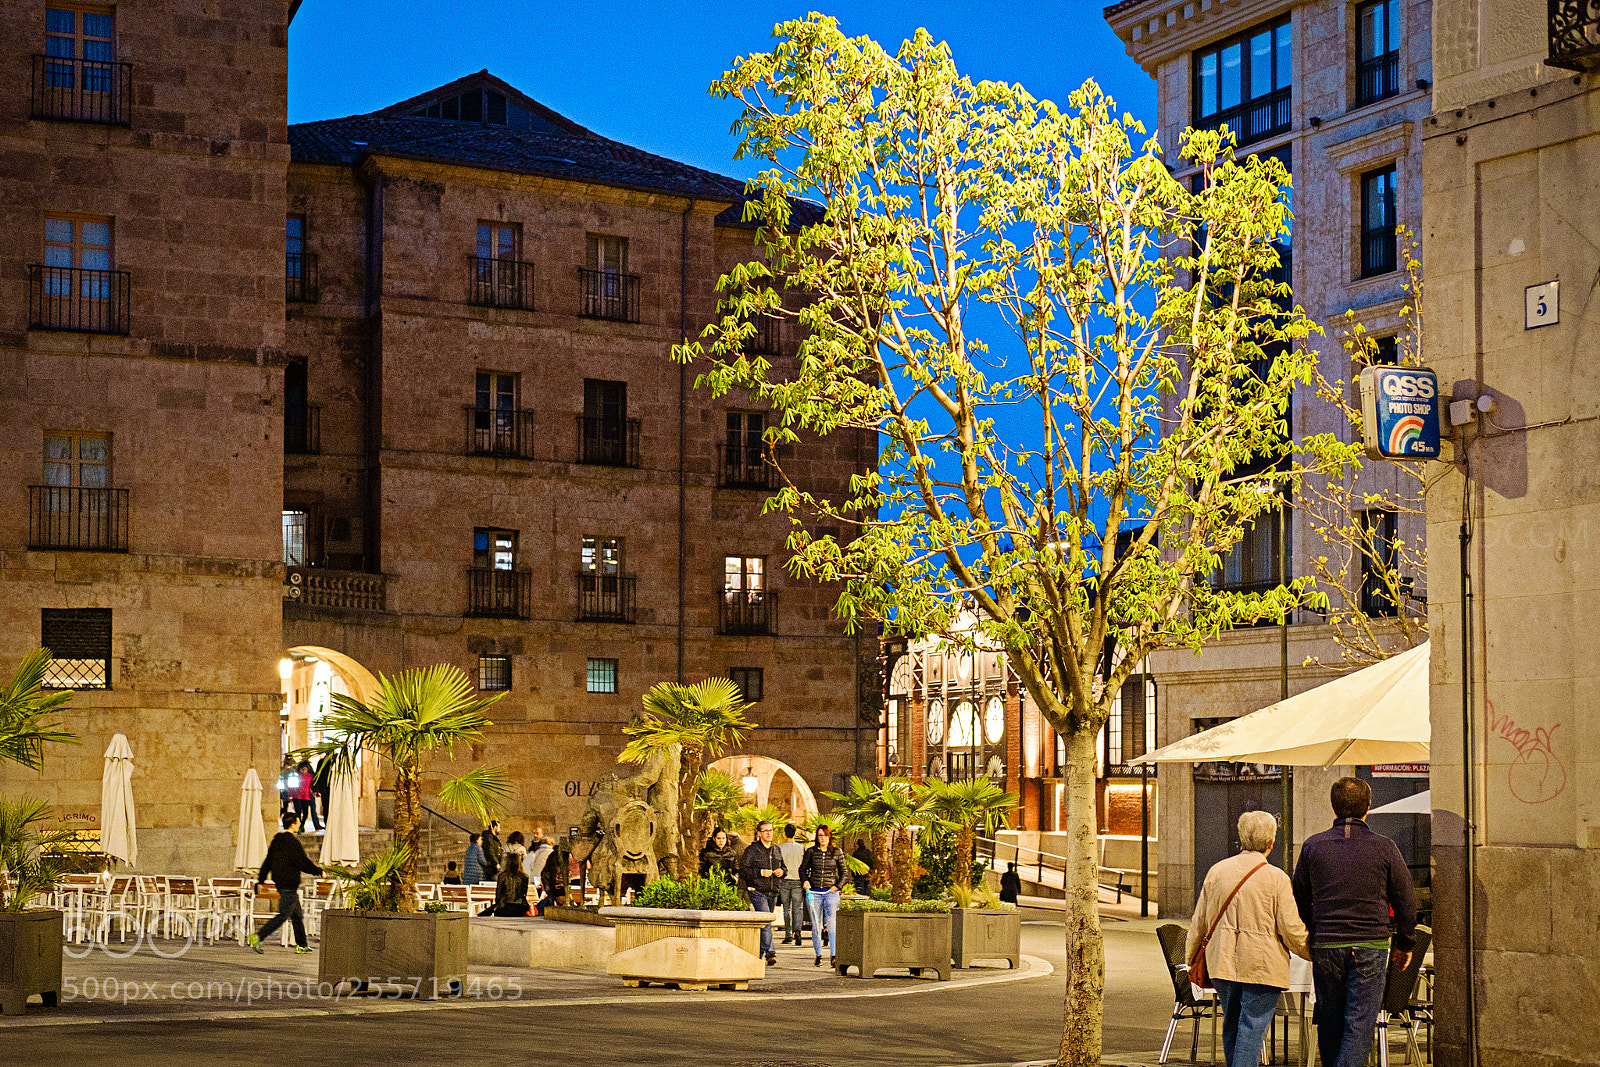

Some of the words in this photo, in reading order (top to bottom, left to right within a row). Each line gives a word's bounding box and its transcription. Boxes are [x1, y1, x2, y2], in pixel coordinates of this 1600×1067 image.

[1537, 295, 1547, 317] 5
[1383, 375, 1434, 398] QSS
[1389, 402, 1413, 414] PHOTO
[1413, 403, 1431, 415] SHOP
[1411, 441, 1425, 453] 45
[57, 812, 96, 823] LIGRIMO
